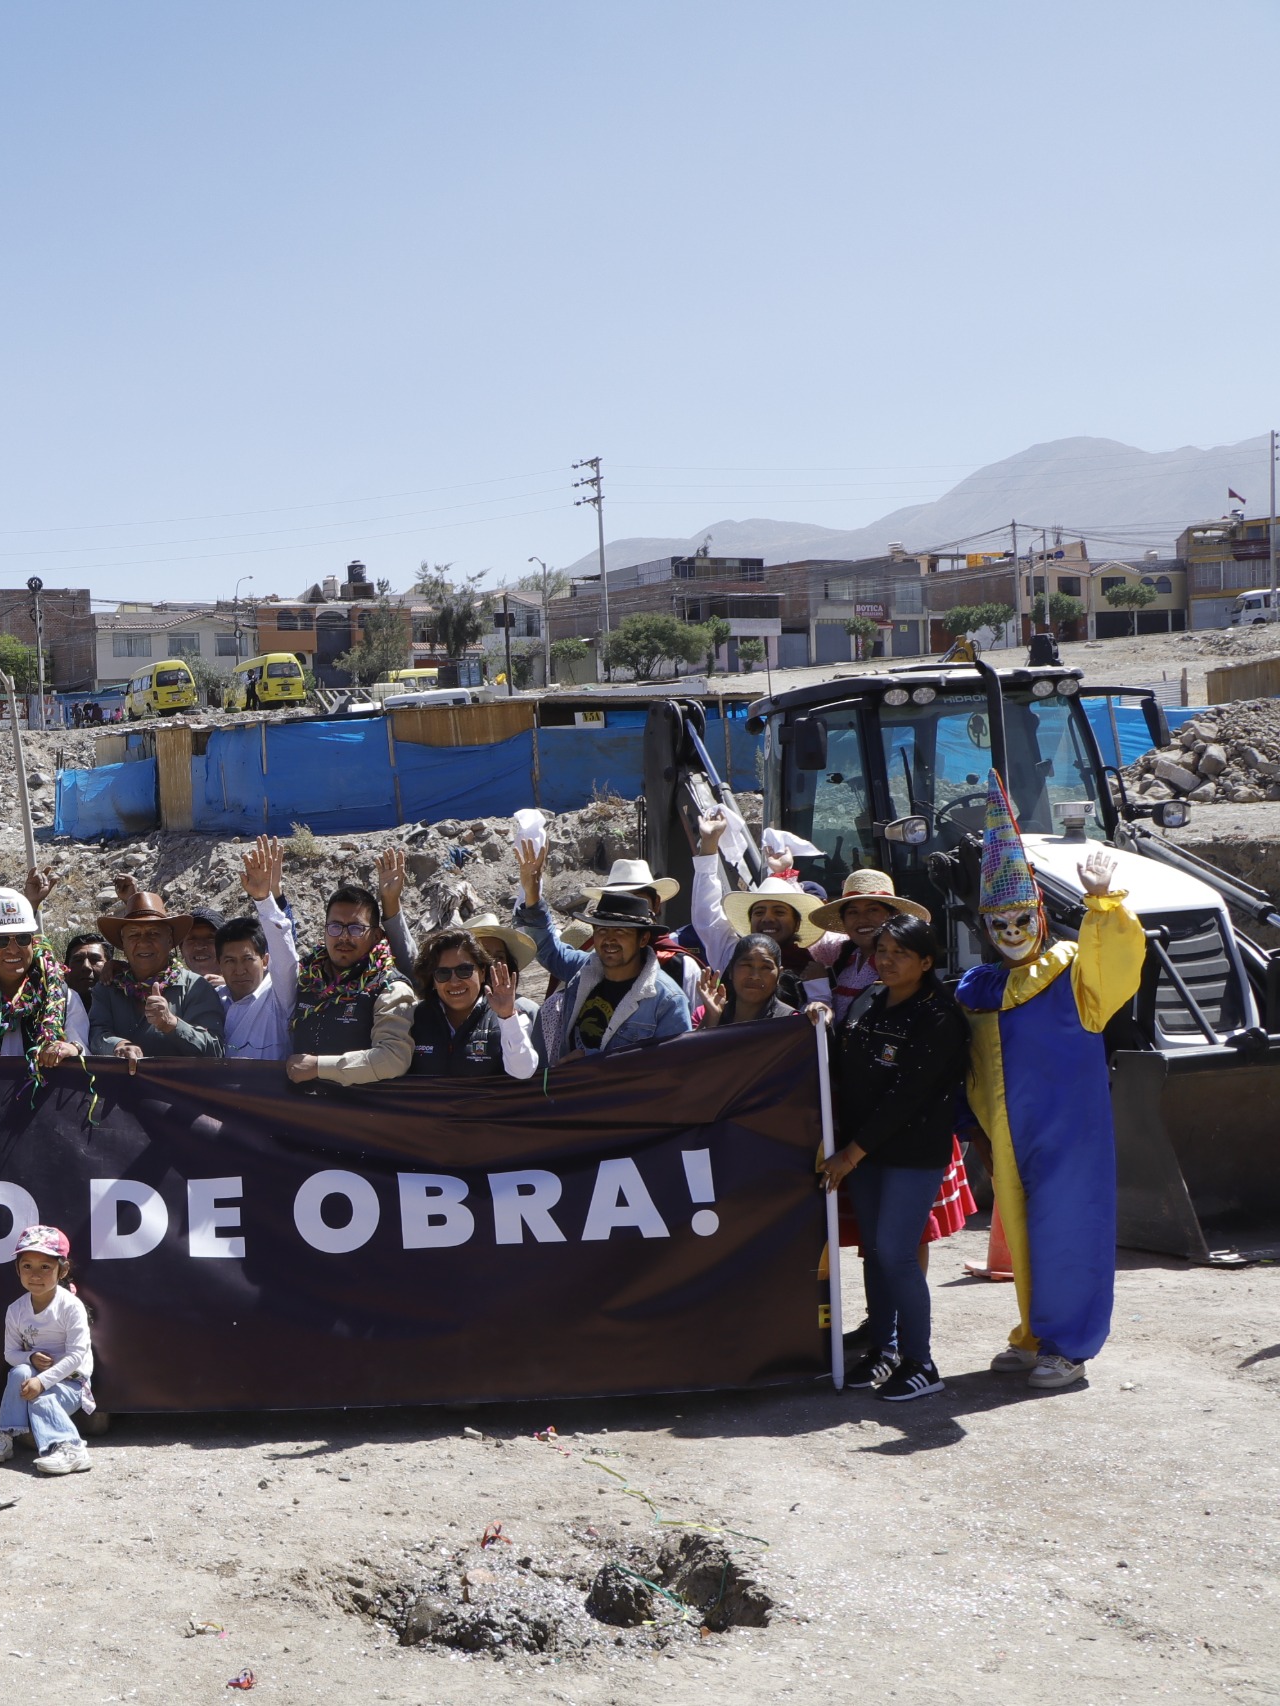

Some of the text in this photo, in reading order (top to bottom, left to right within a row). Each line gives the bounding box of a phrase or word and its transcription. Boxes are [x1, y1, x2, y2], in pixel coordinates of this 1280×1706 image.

[856, 604, 884, 612] BOTICA
[90, 1176, 246, 1260] DE
[293, 1148, 720, 1254] OBRA!
